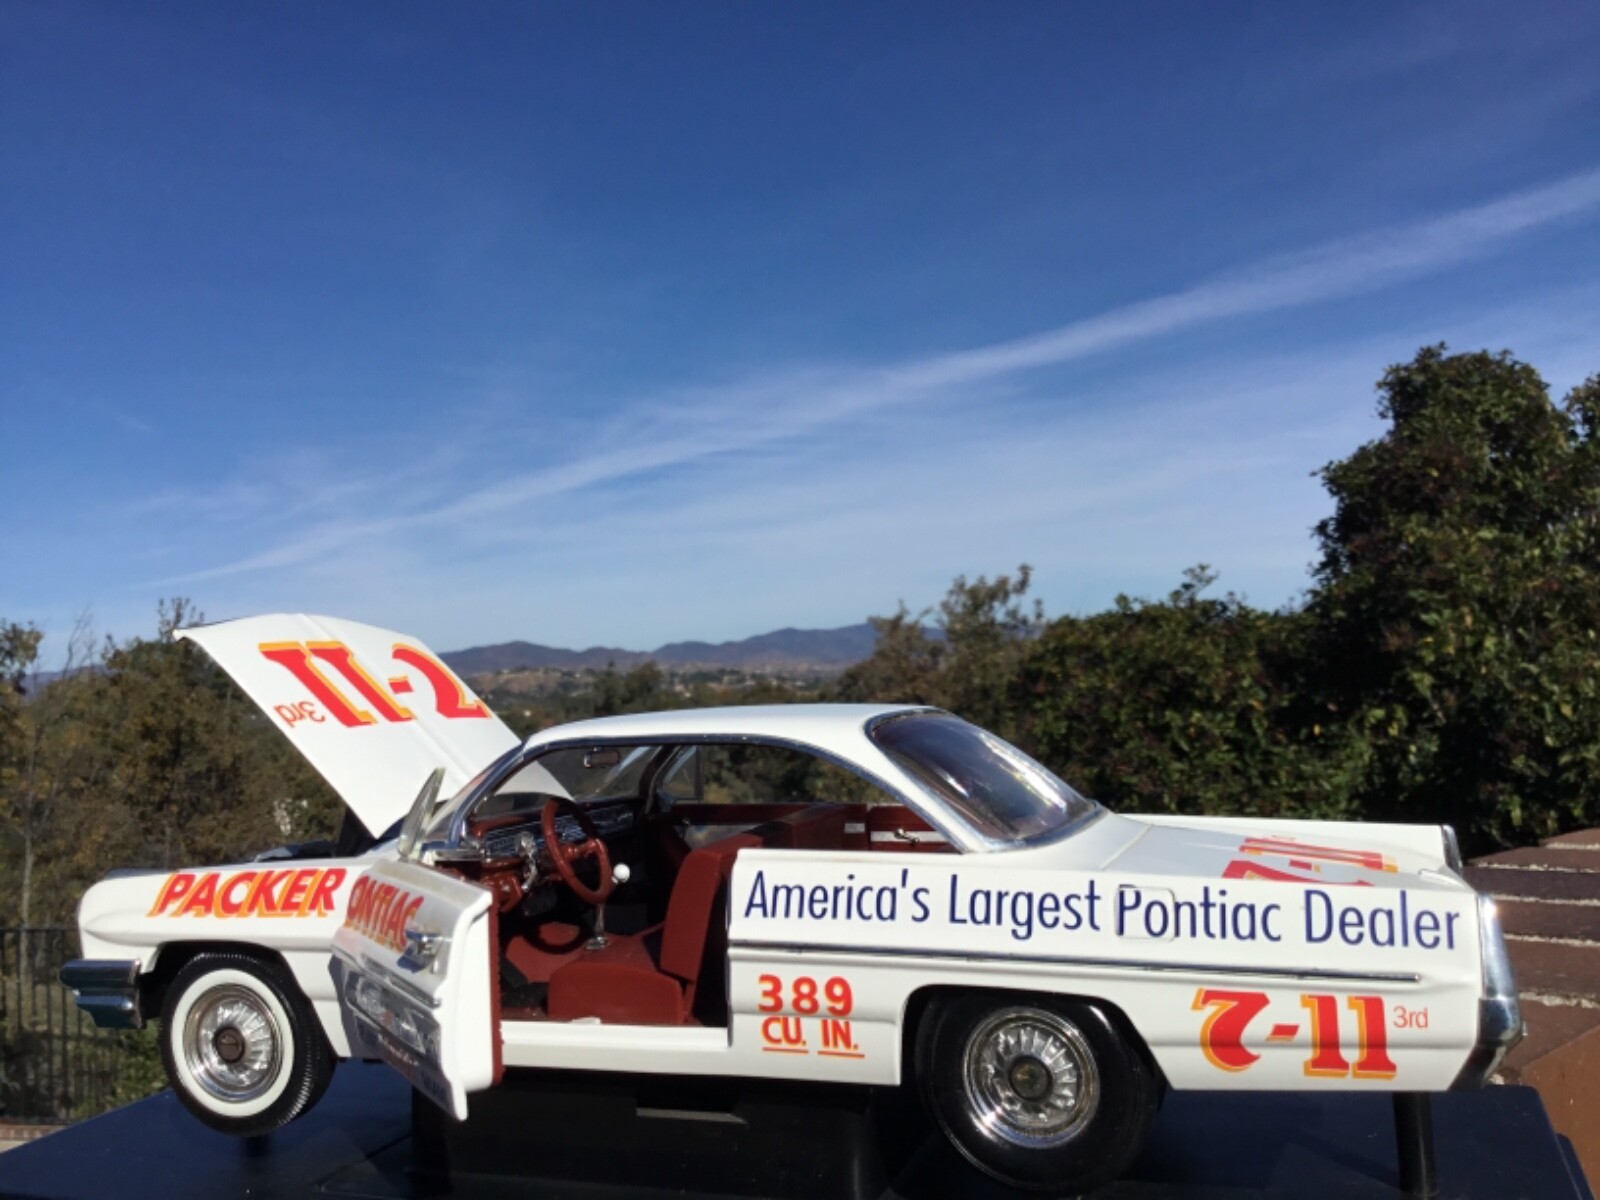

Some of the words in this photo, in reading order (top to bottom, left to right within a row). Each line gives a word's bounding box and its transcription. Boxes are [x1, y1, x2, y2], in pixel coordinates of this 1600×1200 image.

[274, 700, 326, 728] 3rd
[146, 868, 347, 918] PACKER
[344, 874, 425, 954] ONTIAC
[744, 868, 930, 923] America's
[948, 874, 1101, 940] Largest
[1116, 884, 1281, 941] Pontiac
[1305, 890, 1460, 950] Dealer
[757, 974, 854, 1017] 389
[762, 1016, 808, 1046] CU.
[820, 1019, 860, 1050] IN.
[1191, 987, 1397, 1080] 7-11
[1393, 1005, 1429, 1029] 3rd
